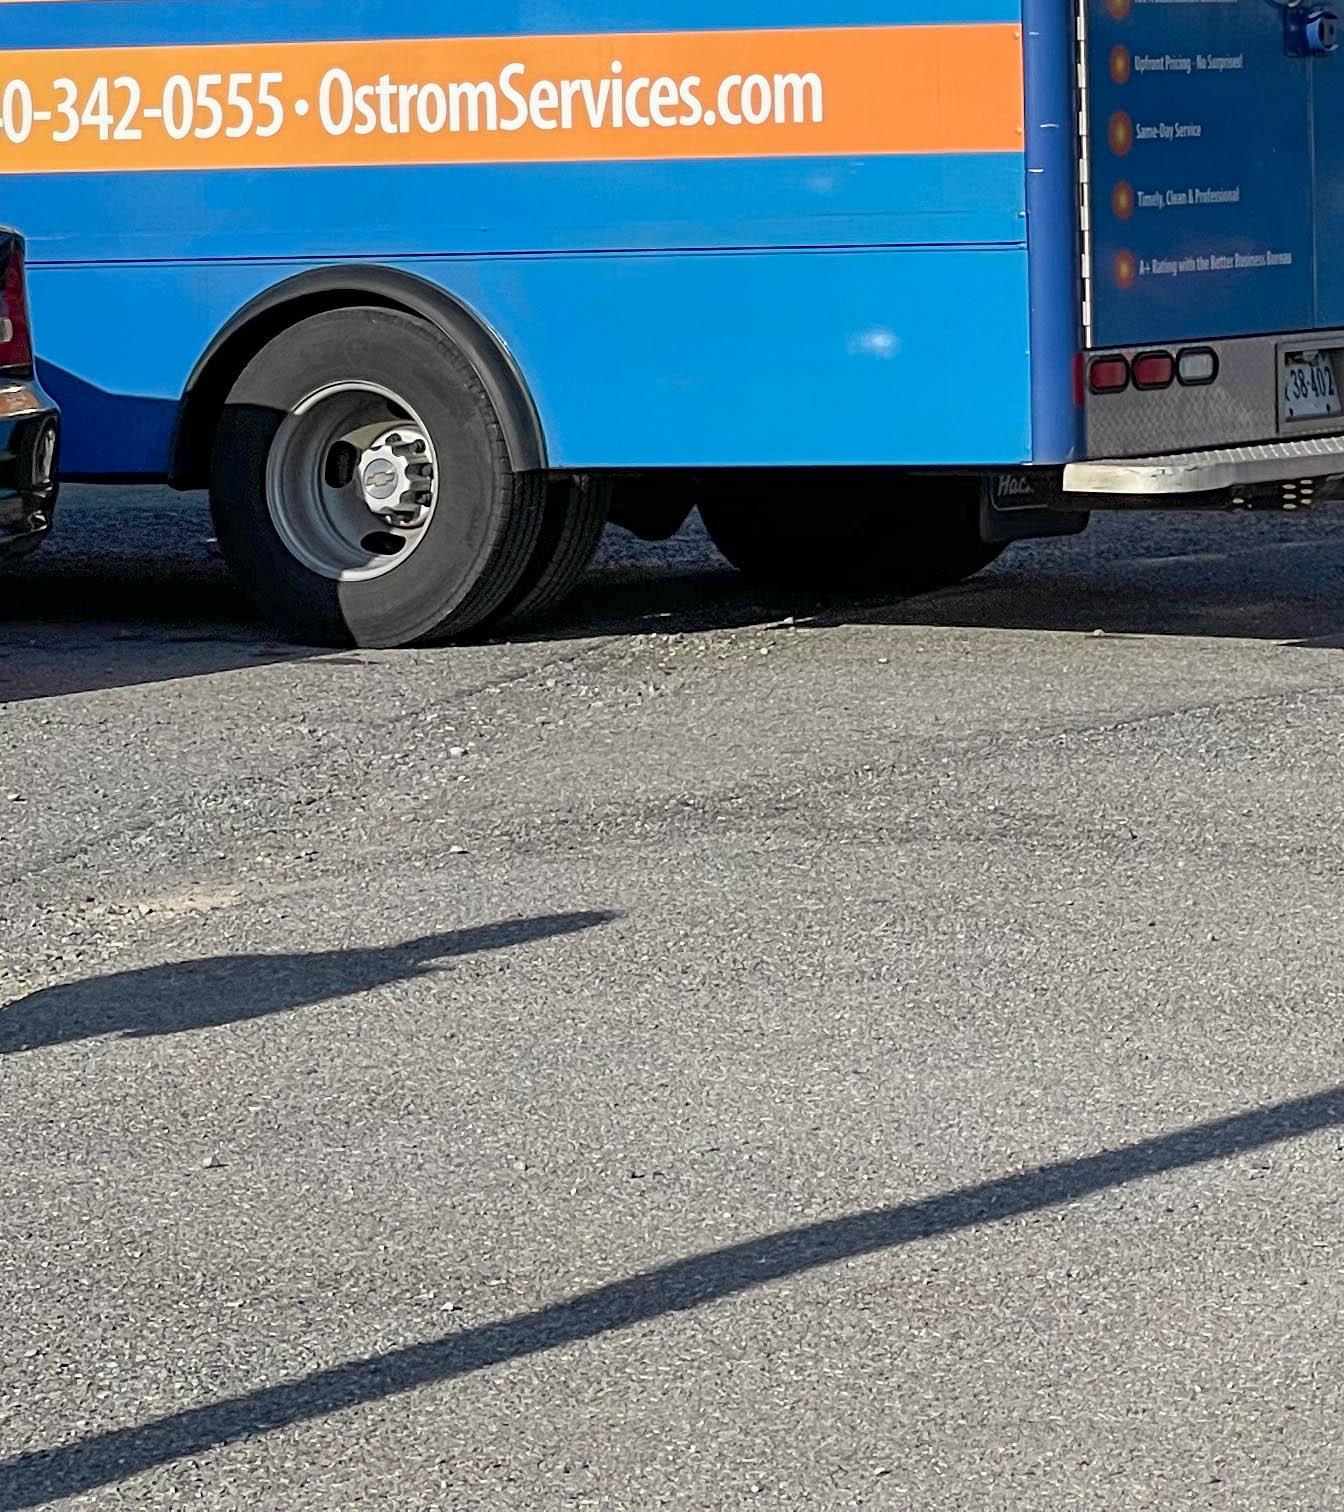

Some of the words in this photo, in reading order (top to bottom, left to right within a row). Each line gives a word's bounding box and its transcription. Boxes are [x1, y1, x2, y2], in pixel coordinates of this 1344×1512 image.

[0, 71, 284, 144] 0-342-0555
[319, 60, 823, 136] OstromServices.com
[1136, 123, 1173, 141] Same-Day
[1175, 123, 1201, 138] Service
